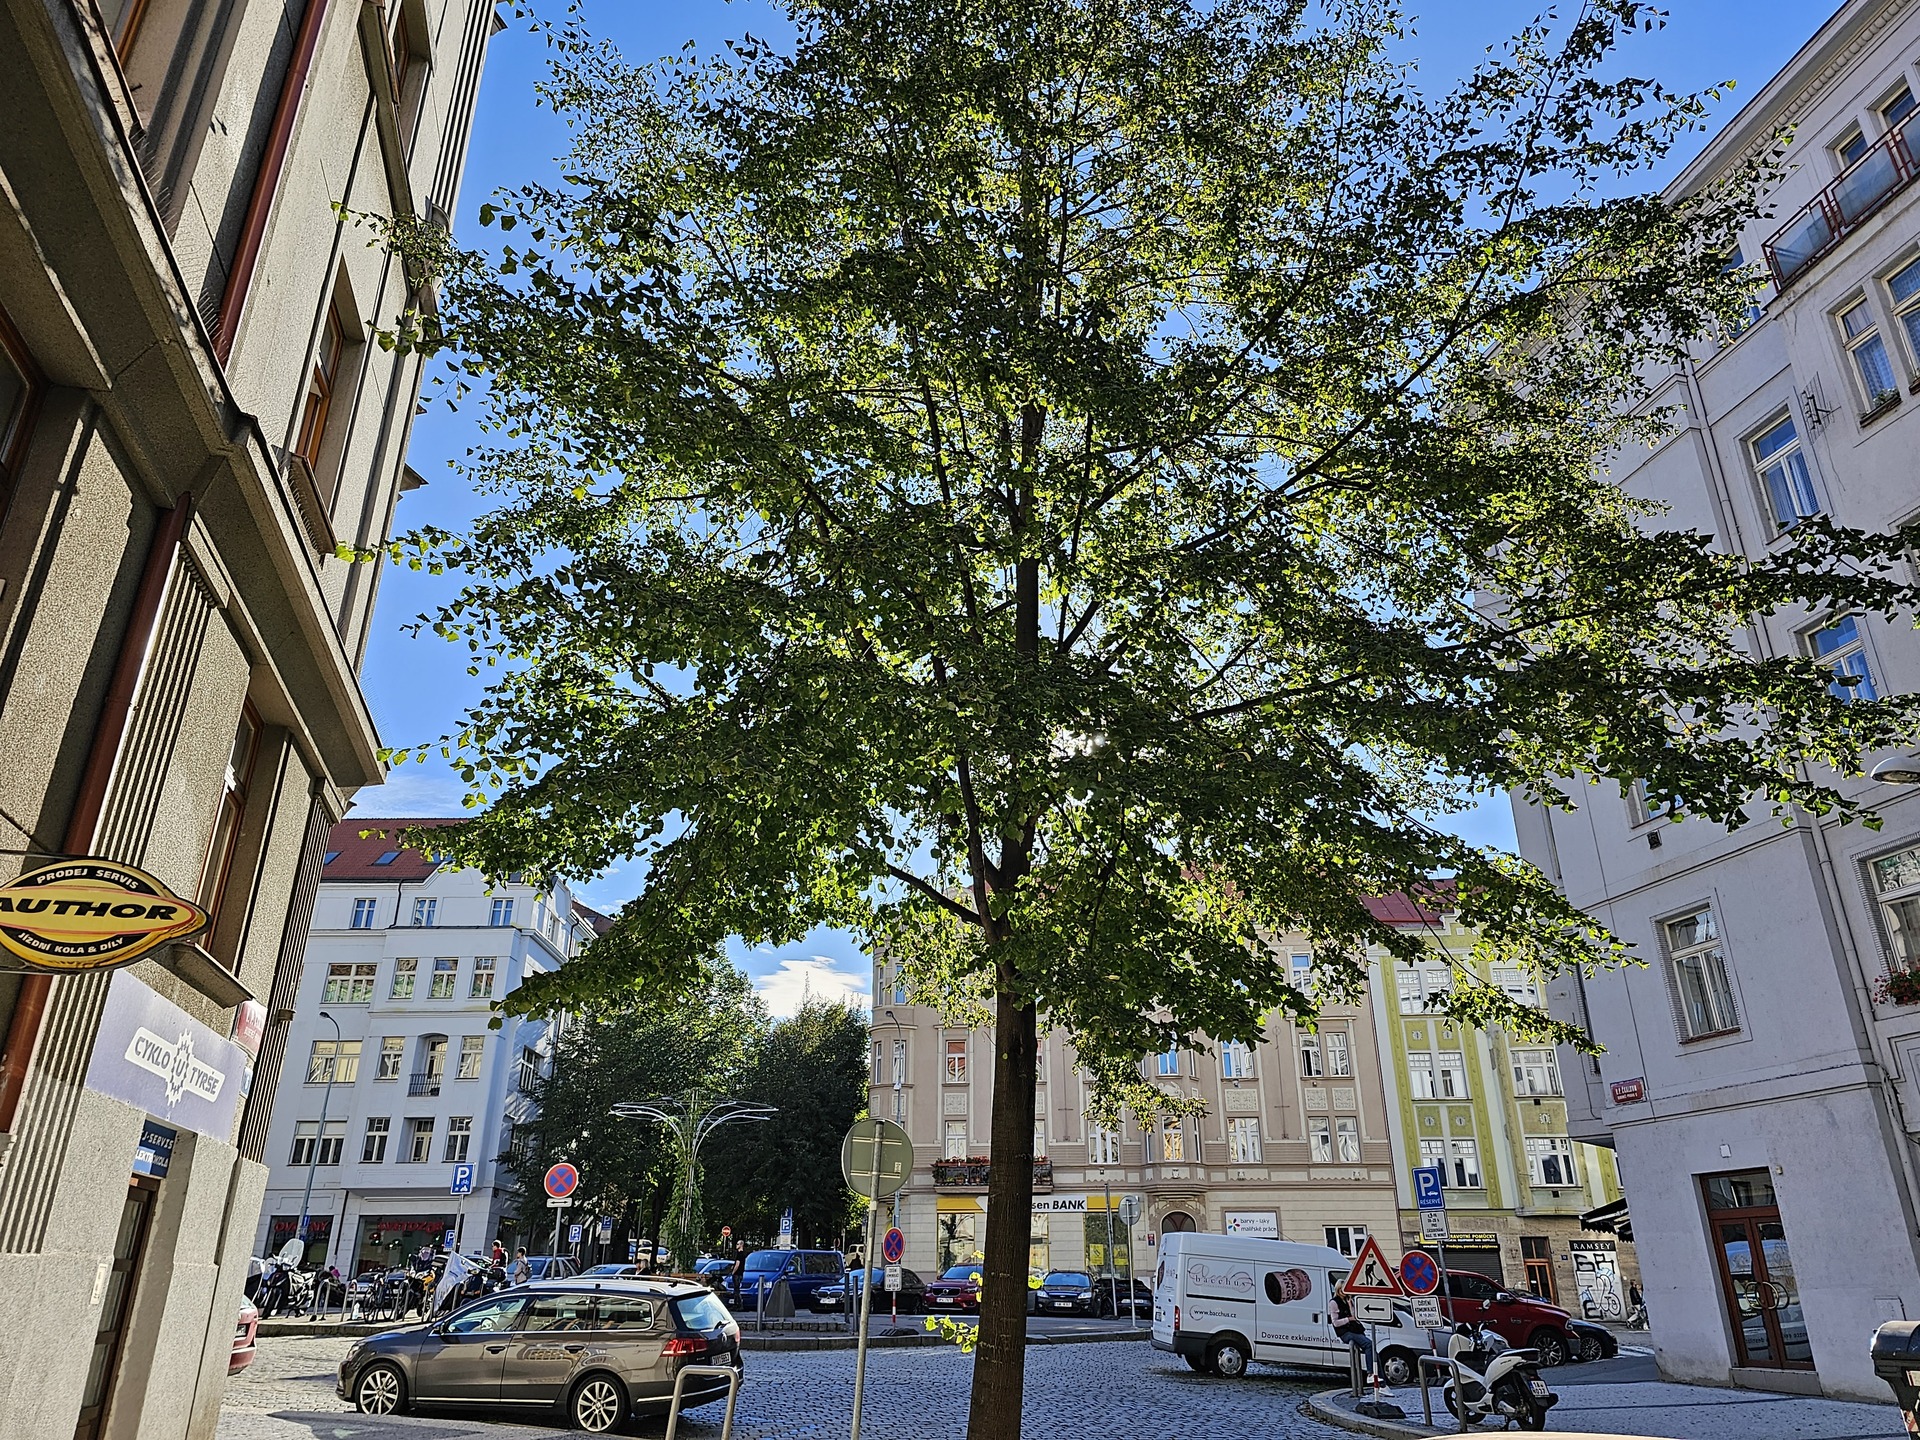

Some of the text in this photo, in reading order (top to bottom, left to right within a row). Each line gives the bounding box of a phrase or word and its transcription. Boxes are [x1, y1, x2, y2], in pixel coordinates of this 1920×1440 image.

[36, 868, 139, 890] PRODEJ SERVIS
[0, 897, 178, 920] AUTHOR
[17, 932, 52, 951] JÍZDNÍ
[54, 945, 85, 954] KOLA
[100, 936, 124, 951] DÍLY
[134, 1036, 171, 1070] CYKLO
[175, 1058, 186, 1077] U
[189, 1066, 220, 1095] TYRŠE
[456, 1167, 470, 1184] P
[1418, 1172, 1434, 1197] P
[1052, 1200, 1085, 1210] BANK
[572, 1227, 579, 1237] P
[783, 1220, 789, 1230] P
[1194, 1310, 1236, 1318] www.bacchus.cz
[1261, 1332, 1289, 1340] Dovozce
